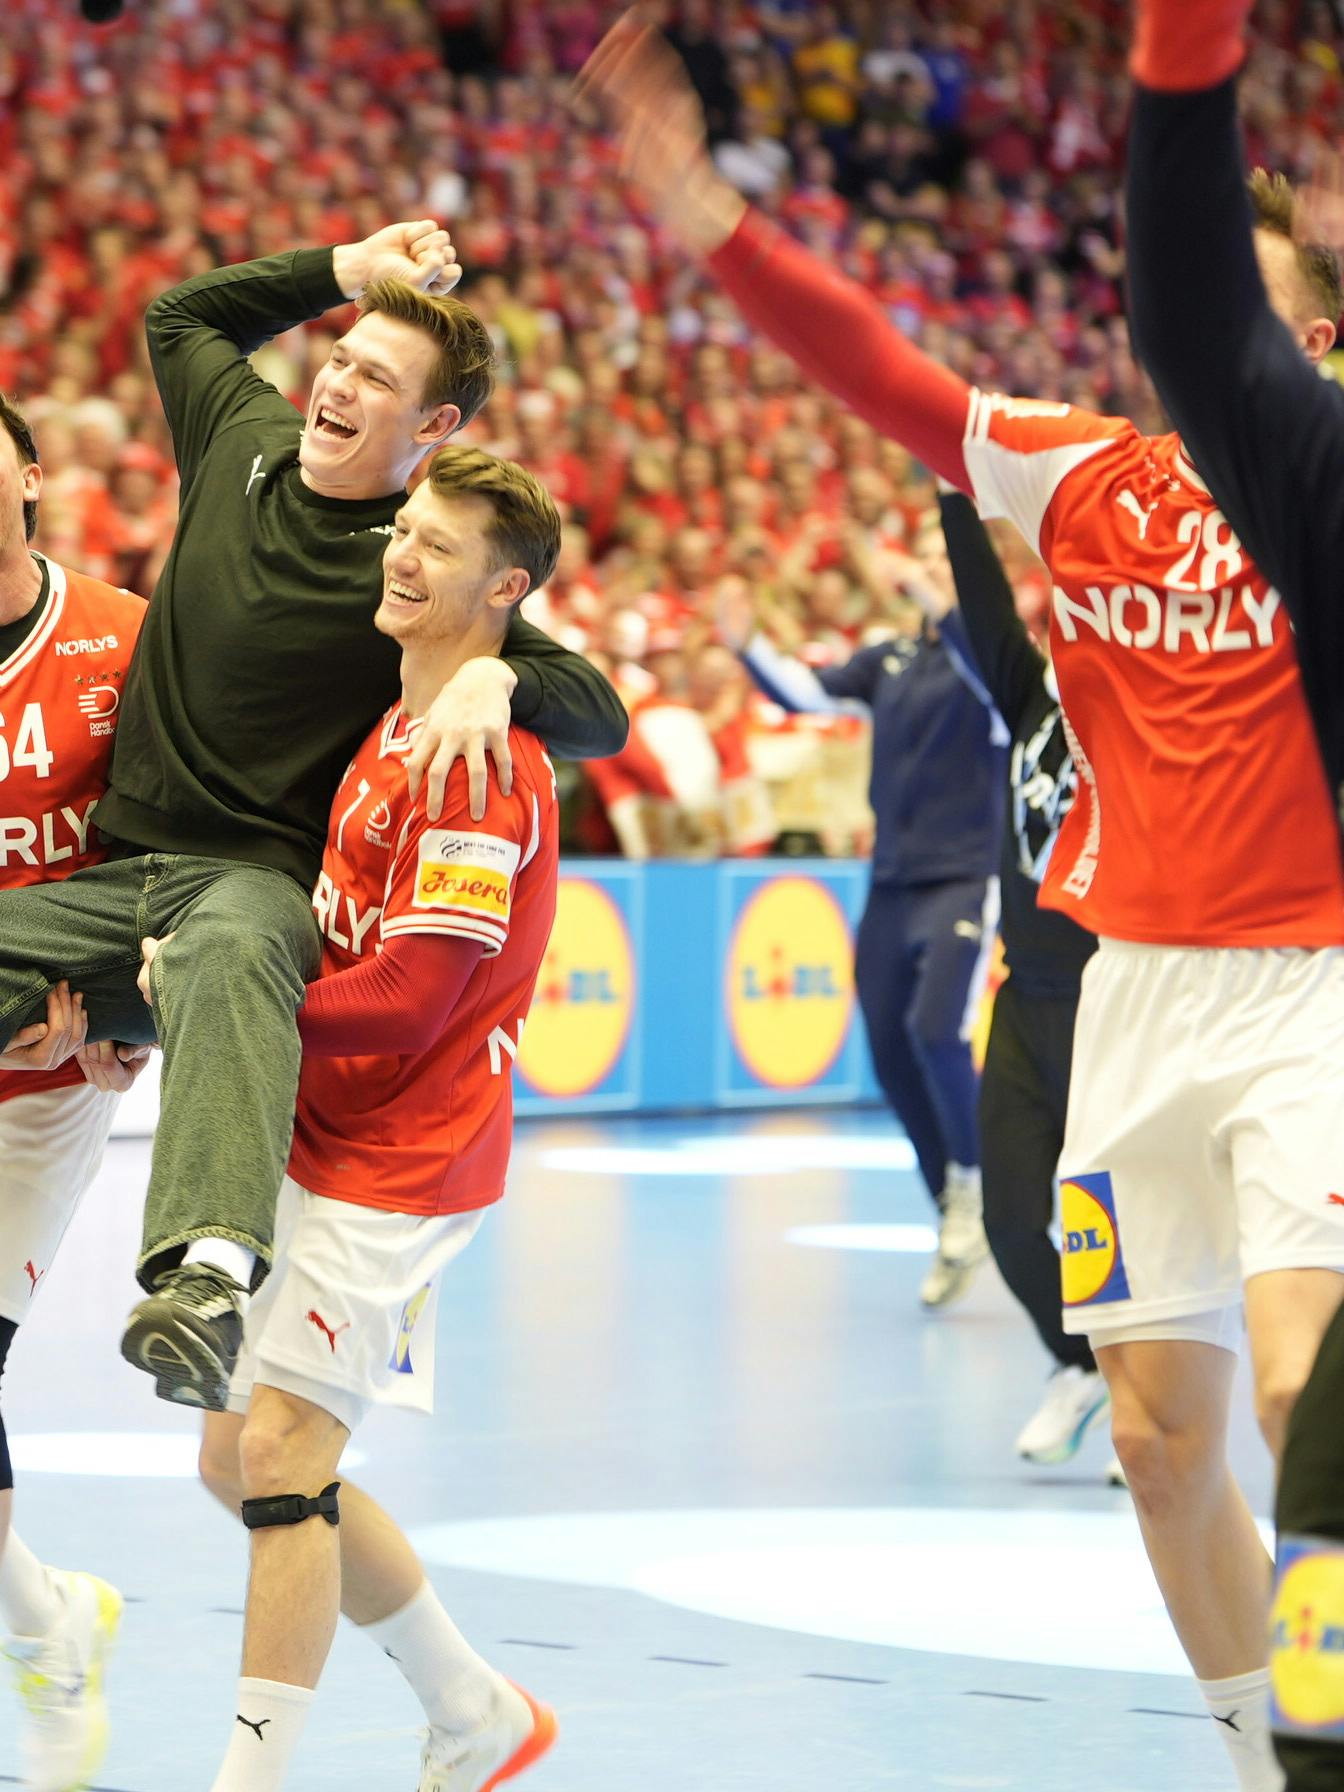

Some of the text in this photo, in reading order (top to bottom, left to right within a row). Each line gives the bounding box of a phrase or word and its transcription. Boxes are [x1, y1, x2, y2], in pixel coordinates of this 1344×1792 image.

[1163, 509, 1243, 592] 28
[1052, 584, 1282, 653] NORLY
[54, 634, 119, 657] NORLYS
[312, 869, 384, 956] RLY
[422, 870, 507, 904] Josera
[1062, 1227, 1108, 1255] DL
